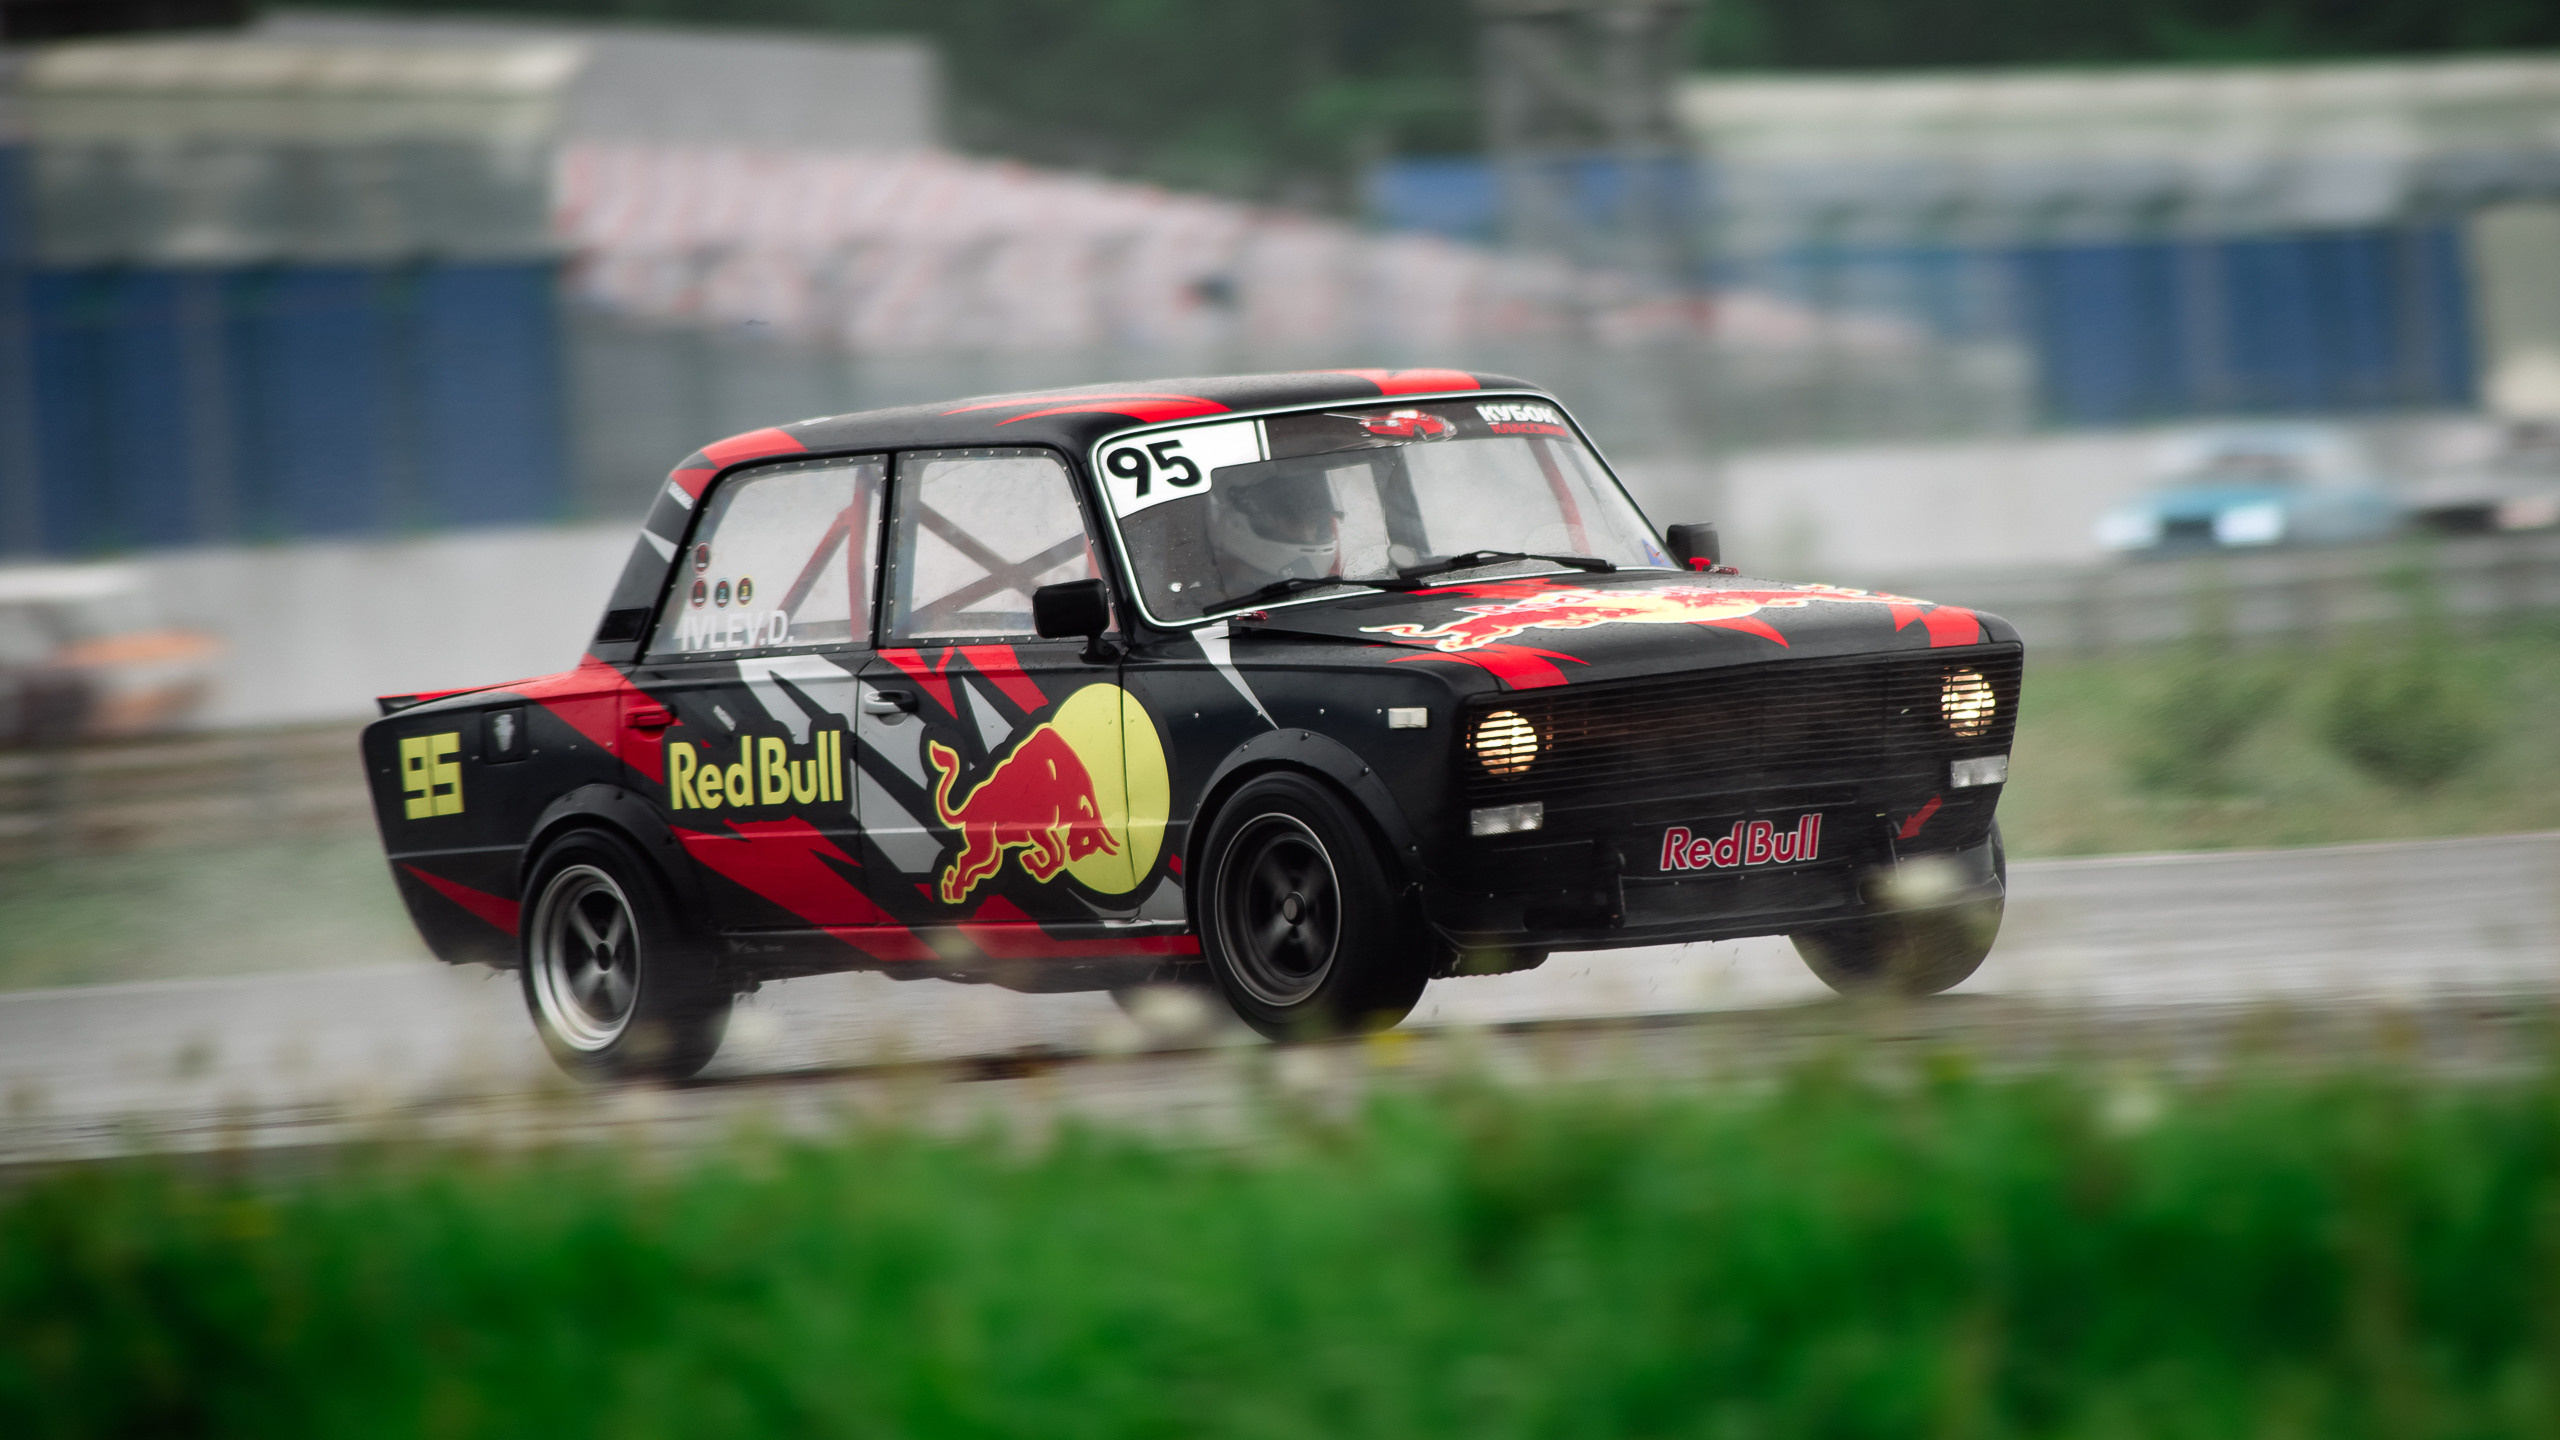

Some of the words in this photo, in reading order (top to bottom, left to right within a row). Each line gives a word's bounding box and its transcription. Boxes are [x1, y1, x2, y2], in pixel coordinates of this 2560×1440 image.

[1475, 404, 1560, 425] КУБОК
[1106, 439, 1202, 498] 95
[399, 732, 465, 820] 95
[669, 735, 755, 810] Red
[759, 730, 844, 806] Bull
[1660, 820, 1745, 871] Red
[1745, 813, 1823, 866] Bull
